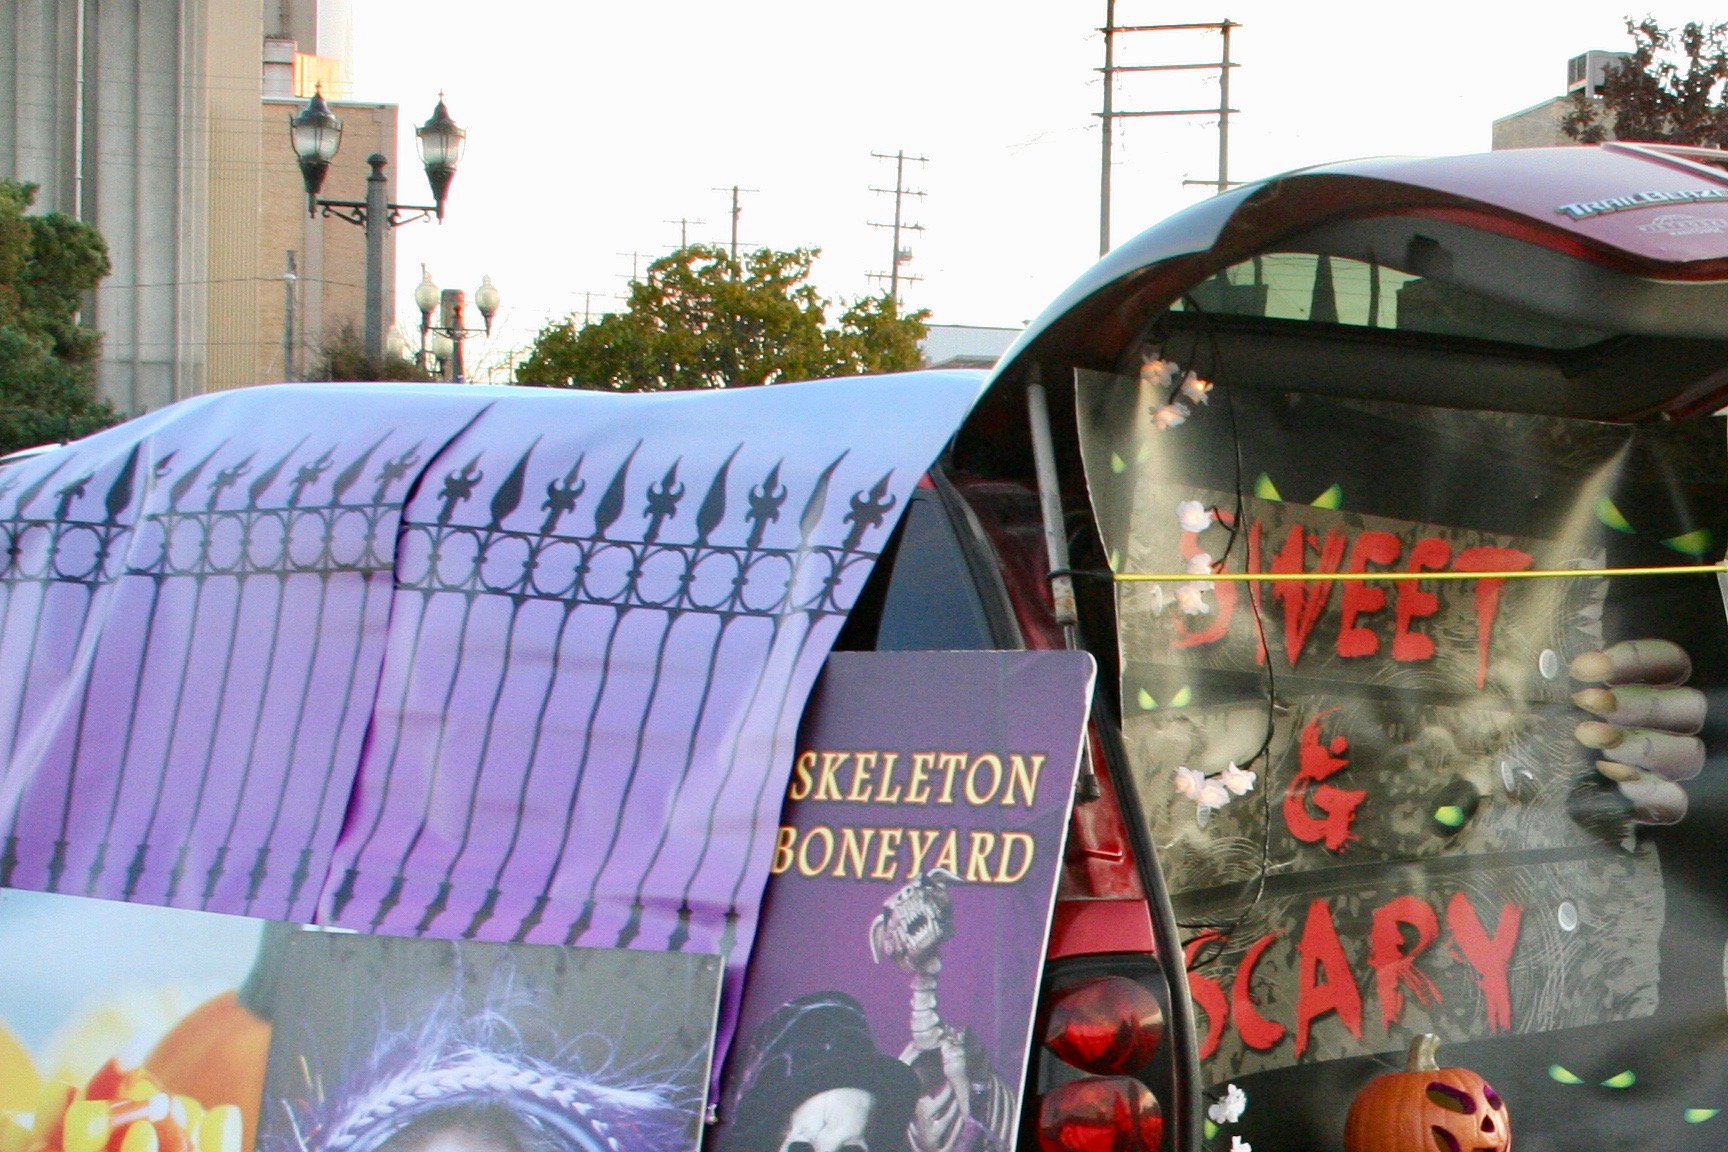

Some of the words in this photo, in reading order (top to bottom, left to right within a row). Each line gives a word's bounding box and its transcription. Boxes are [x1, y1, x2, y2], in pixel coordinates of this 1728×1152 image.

[1170, 508, 1536, 688] SWEET
[790, 750, 1046, 806] SKELETON
[770, 825, 1036, 883] BONEYARD
[1184, 892, 1524, 1061] SCARY
